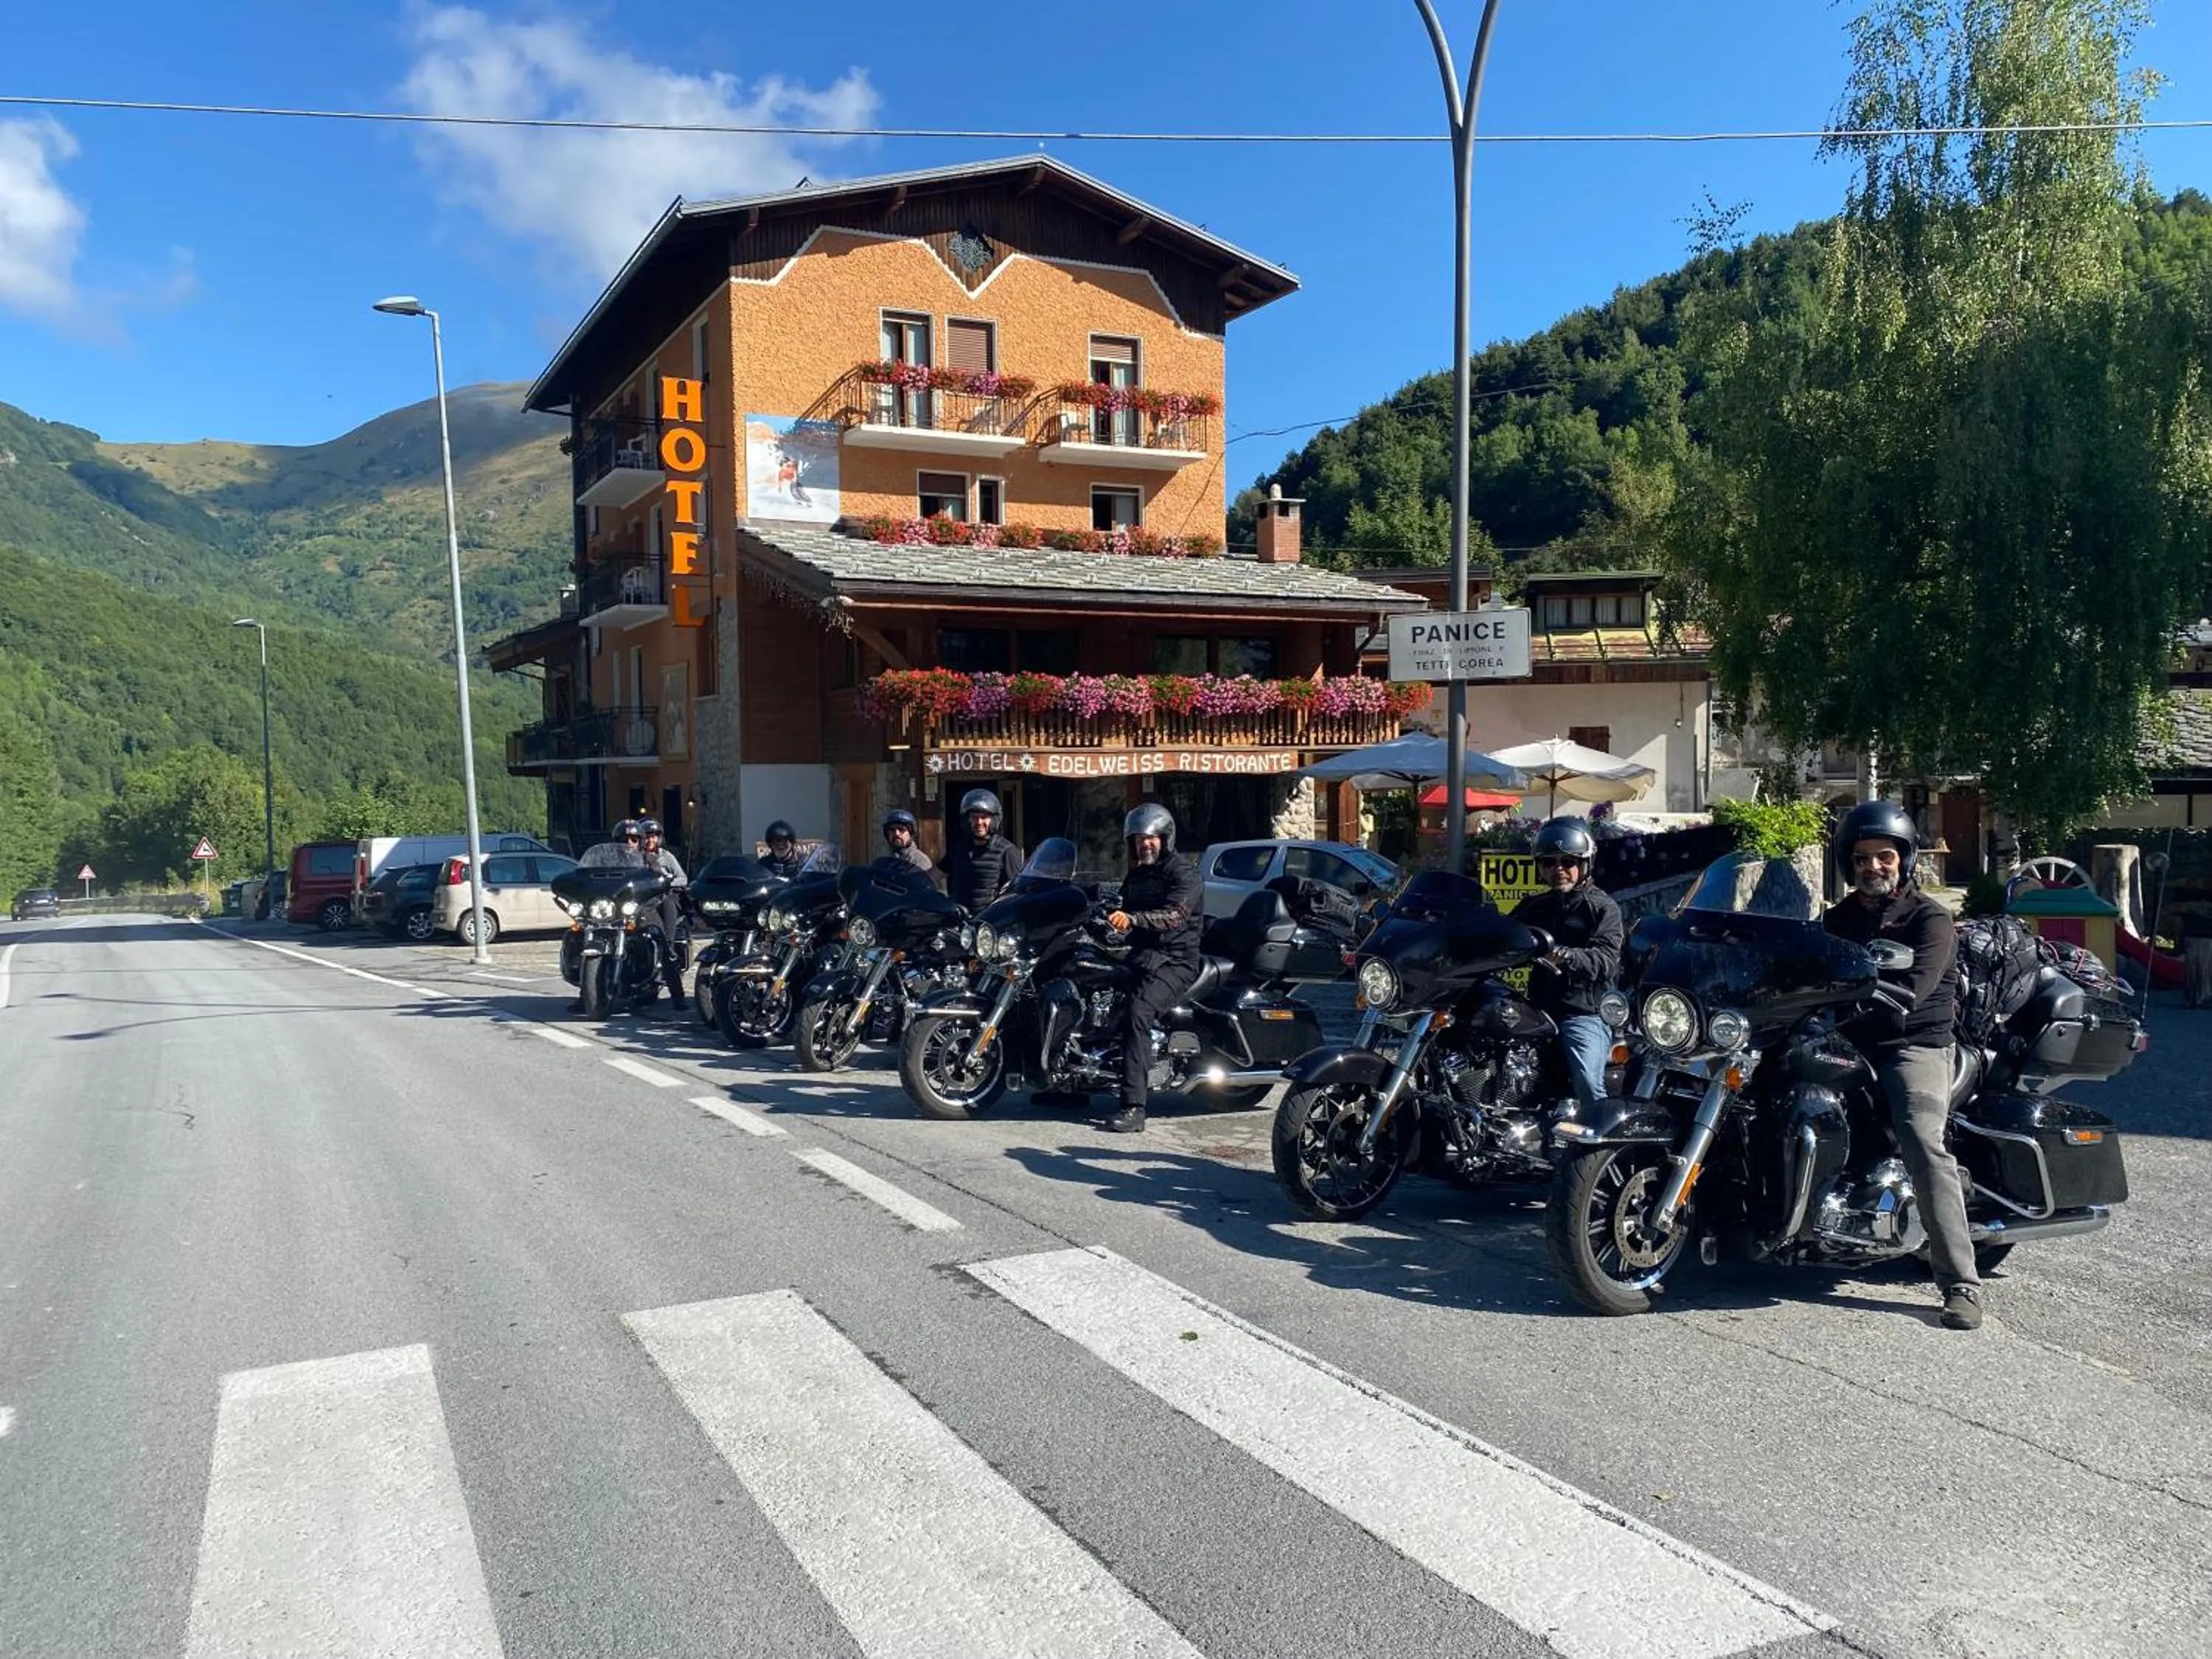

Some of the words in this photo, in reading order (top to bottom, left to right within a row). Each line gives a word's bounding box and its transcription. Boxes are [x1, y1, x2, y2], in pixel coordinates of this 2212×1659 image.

[661, 375, 706, 627] HOTEL
[1412, 622, 1506, 644] PANICE
[1415, 661, 1450, 671] TETTI
[1458, 658, 1504, 669] COREA
[947, 752, 1015, 772] HOTEL
[1048, 752, 1165, 773] EDELWEISS
[1179, 753, 1292, 772] RISTORANTE
